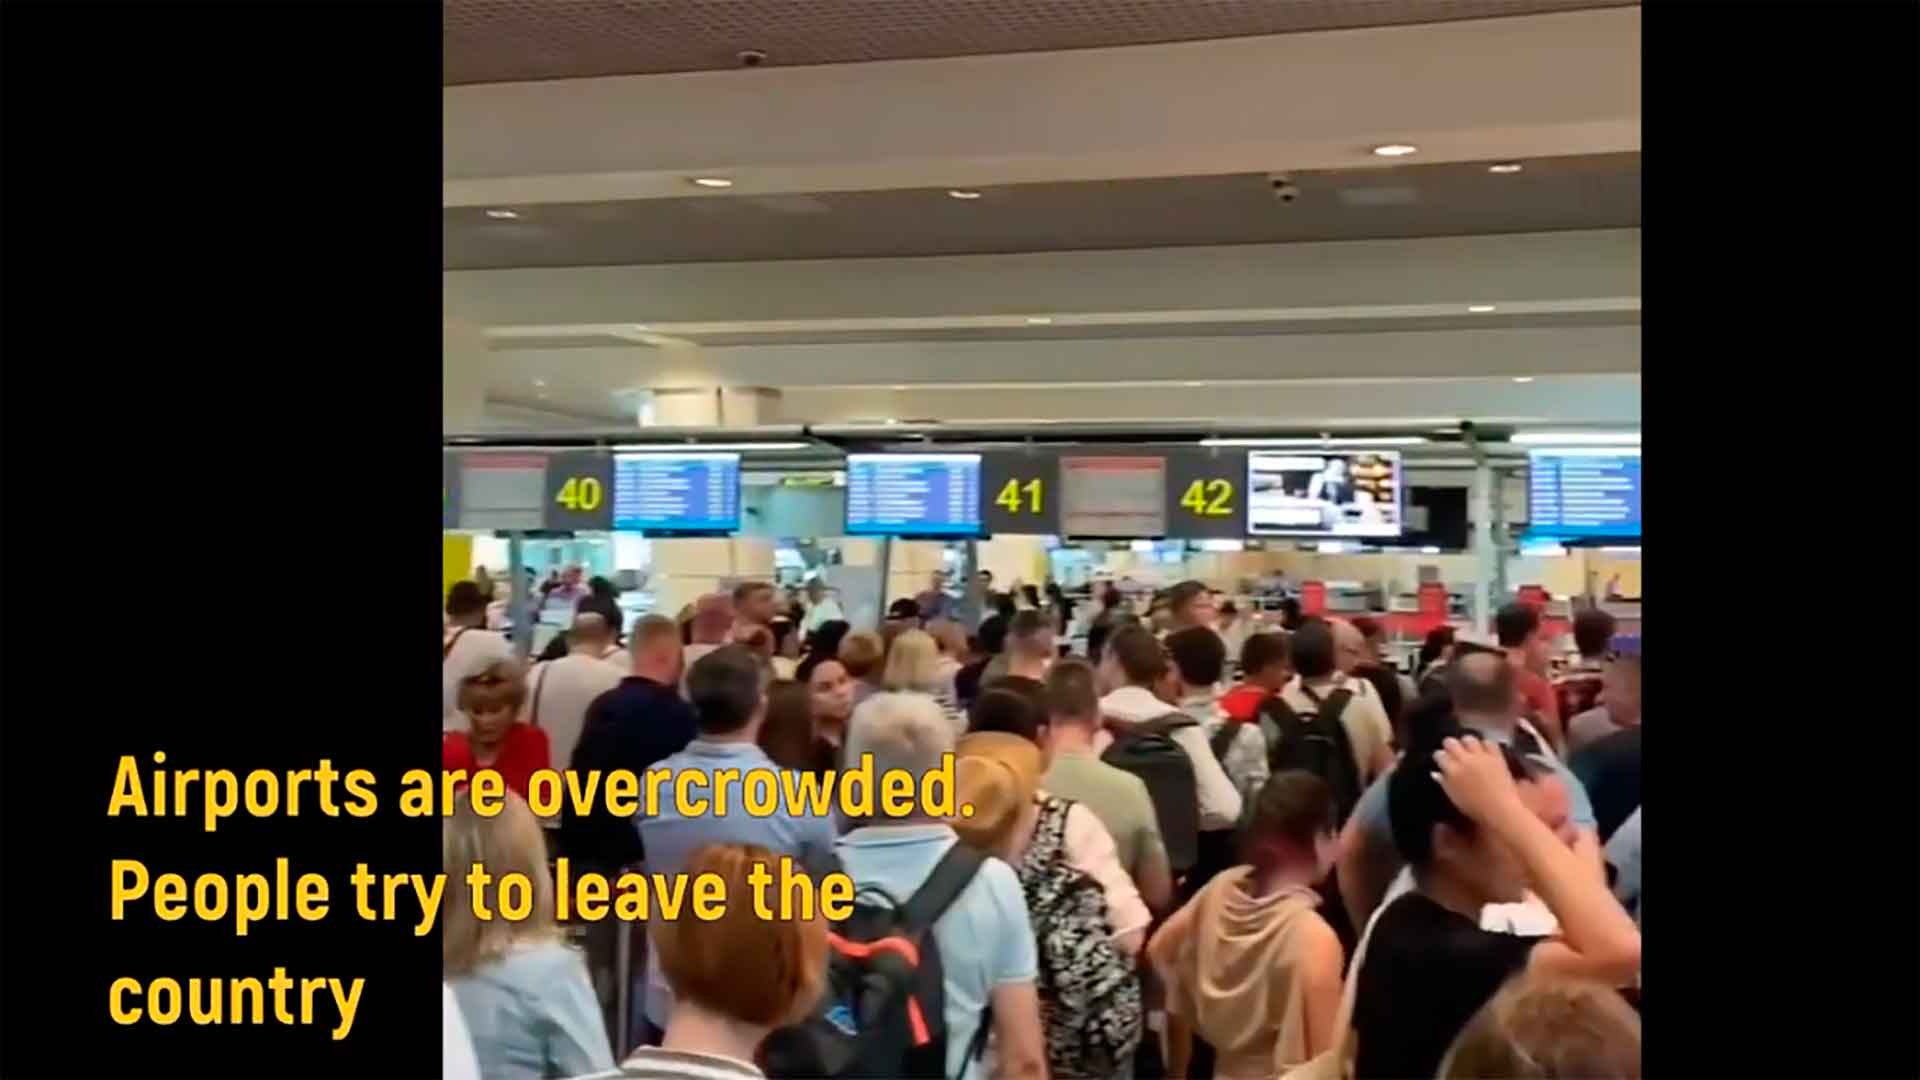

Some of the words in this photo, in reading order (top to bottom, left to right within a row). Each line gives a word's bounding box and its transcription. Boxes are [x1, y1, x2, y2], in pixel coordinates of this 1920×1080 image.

[556, 477, 602, 511] 40
[995, 478, 1043, 513] 41
[1180, 479, 1233, 515] 42
